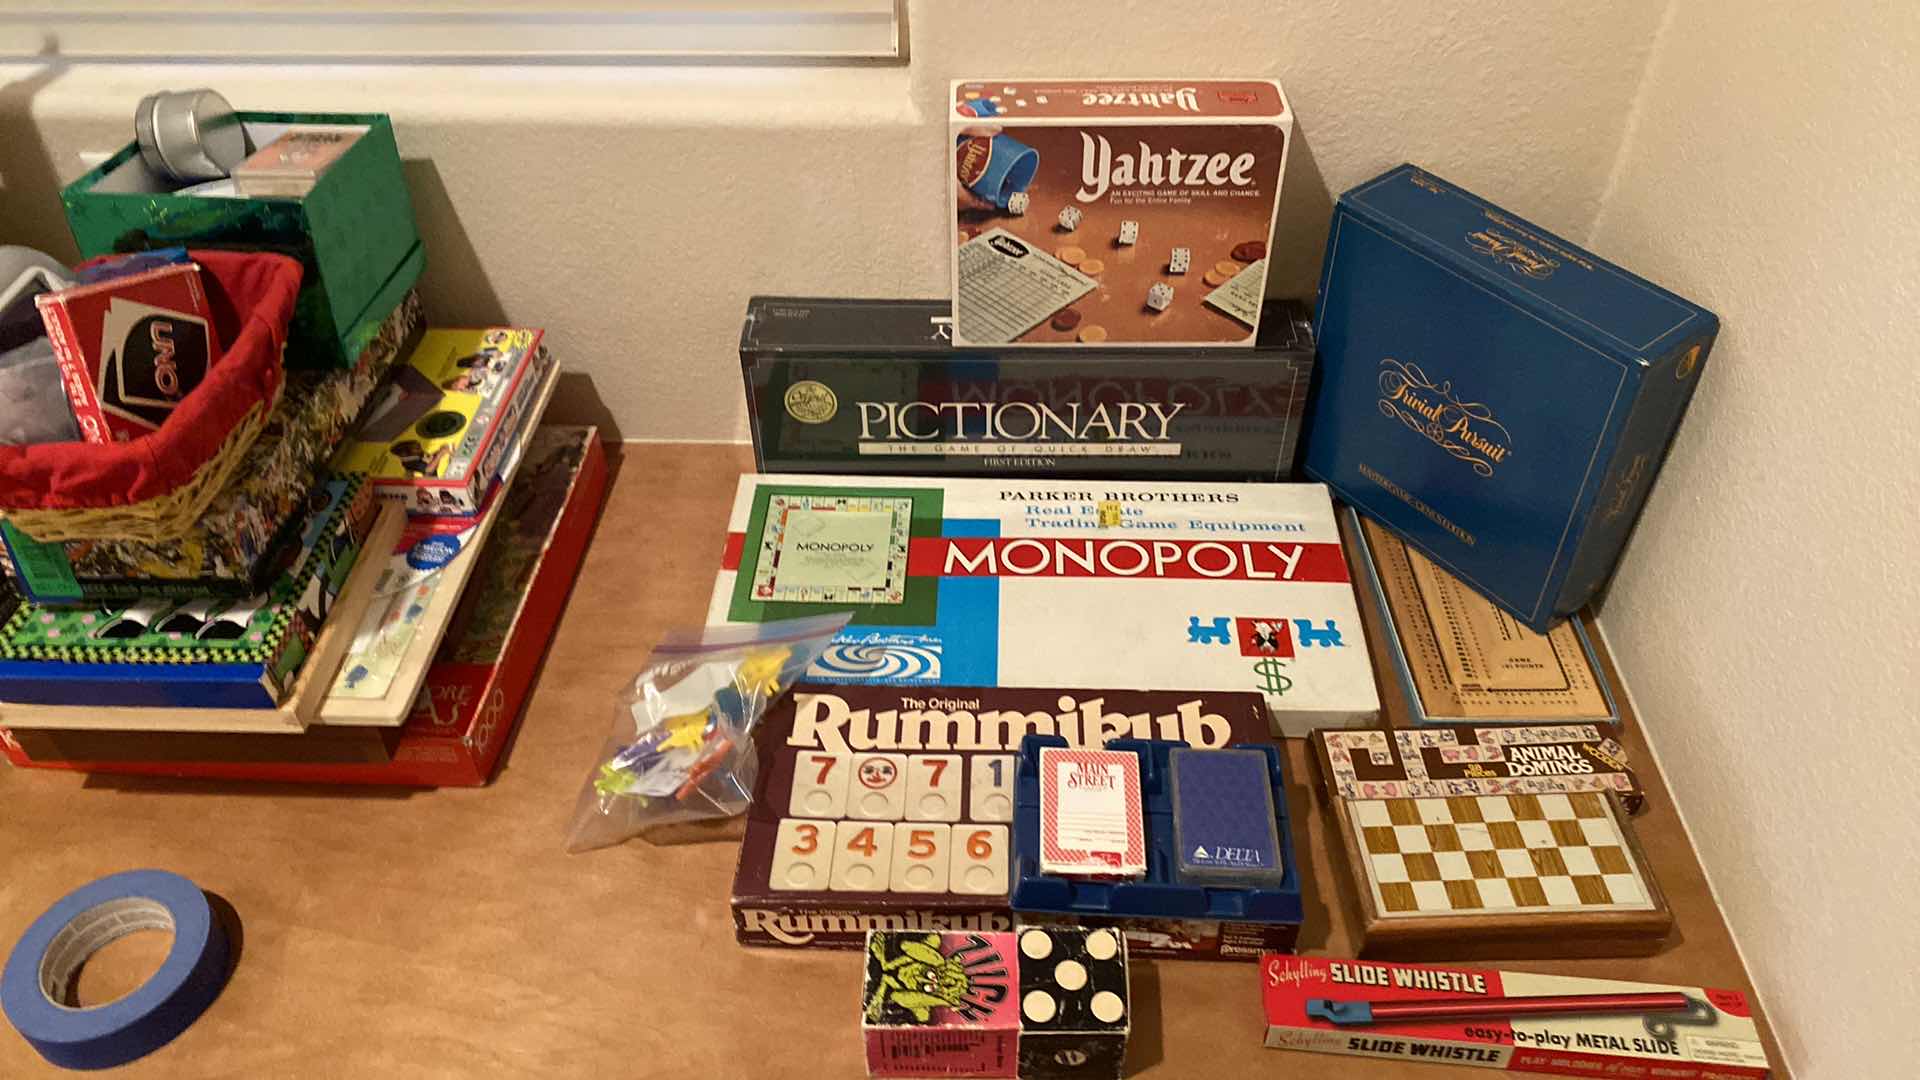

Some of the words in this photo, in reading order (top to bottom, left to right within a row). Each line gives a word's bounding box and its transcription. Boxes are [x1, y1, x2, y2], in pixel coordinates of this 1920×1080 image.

[1083, 87, 1200, 112] Yahtzee
[1075, 130, 1256, 203] Yahtzee
[149, 320, 181, 397] UNO
[856, 401, 1185, 440] PICTIONARY
[889, 445, 918, 453] THE
[934, 445, 980, 453] GAME
[997, 445, 1015, 453] OF
[1034, 445, 1088, 454] QUICK
[1444, 415, 1506, 463] Pursuit
[983, 458, 1012, 467] FIRST
[1013, 458, 1056, 468] EDITION
[1000, 491, 1093, 501] PARKER
[1104, 491, 1240, 503] BROTHERS
[1025, 504, 1071, 516] Real
[1120, 518, 1178, 529] Game
[1188, 519, 1305, 533] Equipment
[796, 542, 875, 552] MONOPOLY
[944, 538, 1304, 580] MONOPOLY
[901, 696, 926, 709] The
[928, 697, 981, 711] Original
[786, 693, 1232, 754] Rummikub
[1510, 744, 1581, 762] ANIMAL
[809, 756, 838, 786] 7
[923, 759, 949, 787] 7
[1076, 762, 1109, 776] MAIN
[1505, 759, 1594, 776] DOMINOS
[1068, 774, 1116, 790] STREET
[792, 825, 818, 856] 3
[847, 826, 878, 857] 4
[909, 829, 936, 860] 5
[966, 830, 993, 860] 6
[1215, 846, 1264, 863] DELTA
[741, 908, 1010, 945] Rummikub
[1330, 962, 1391, 986] SLIDE
[1391, 967, 1488, 994] WHISTLE
[1347, 1037, 1405, 1055] SLIDE
[1409, 1042, 1501, 1062] WHISTLE
[1464, 1024, 1571, 1048] easy-to-play
[1575, 1031, 1630, 1052] METAL
[1633, 1038, 1680, 1056] SLIDE
